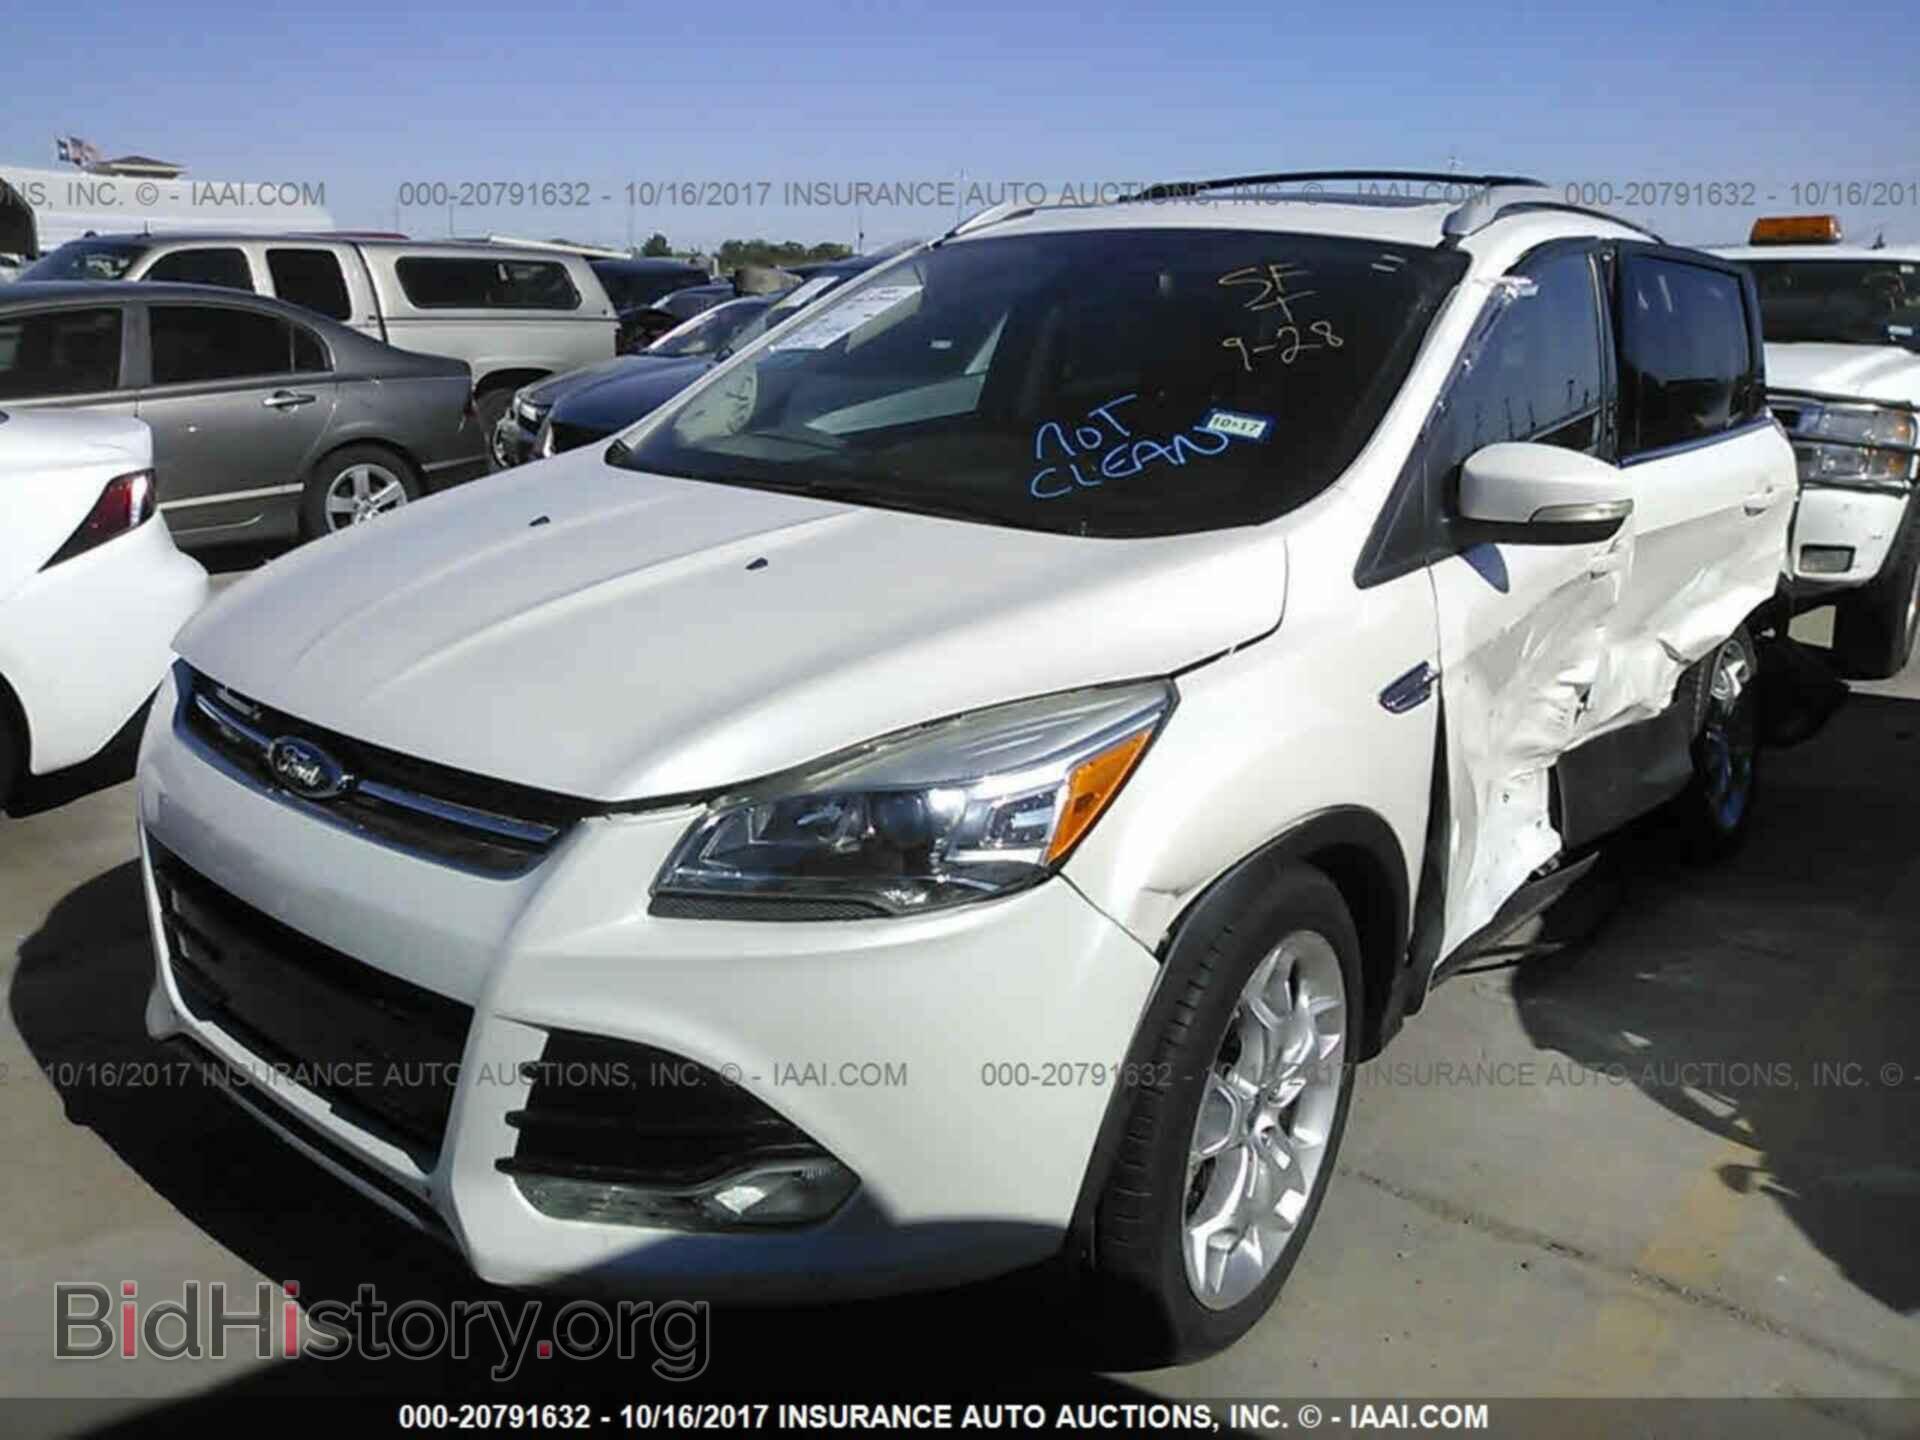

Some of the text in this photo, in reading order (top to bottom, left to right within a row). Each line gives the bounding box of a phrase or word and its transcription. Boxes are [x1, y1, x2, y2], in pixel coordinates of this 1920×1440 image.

[1221, 320, 1345, 372] 9-28
[1031, 425, 1230, 499] CLEAN
[277, 744, 321, 787] Ford
